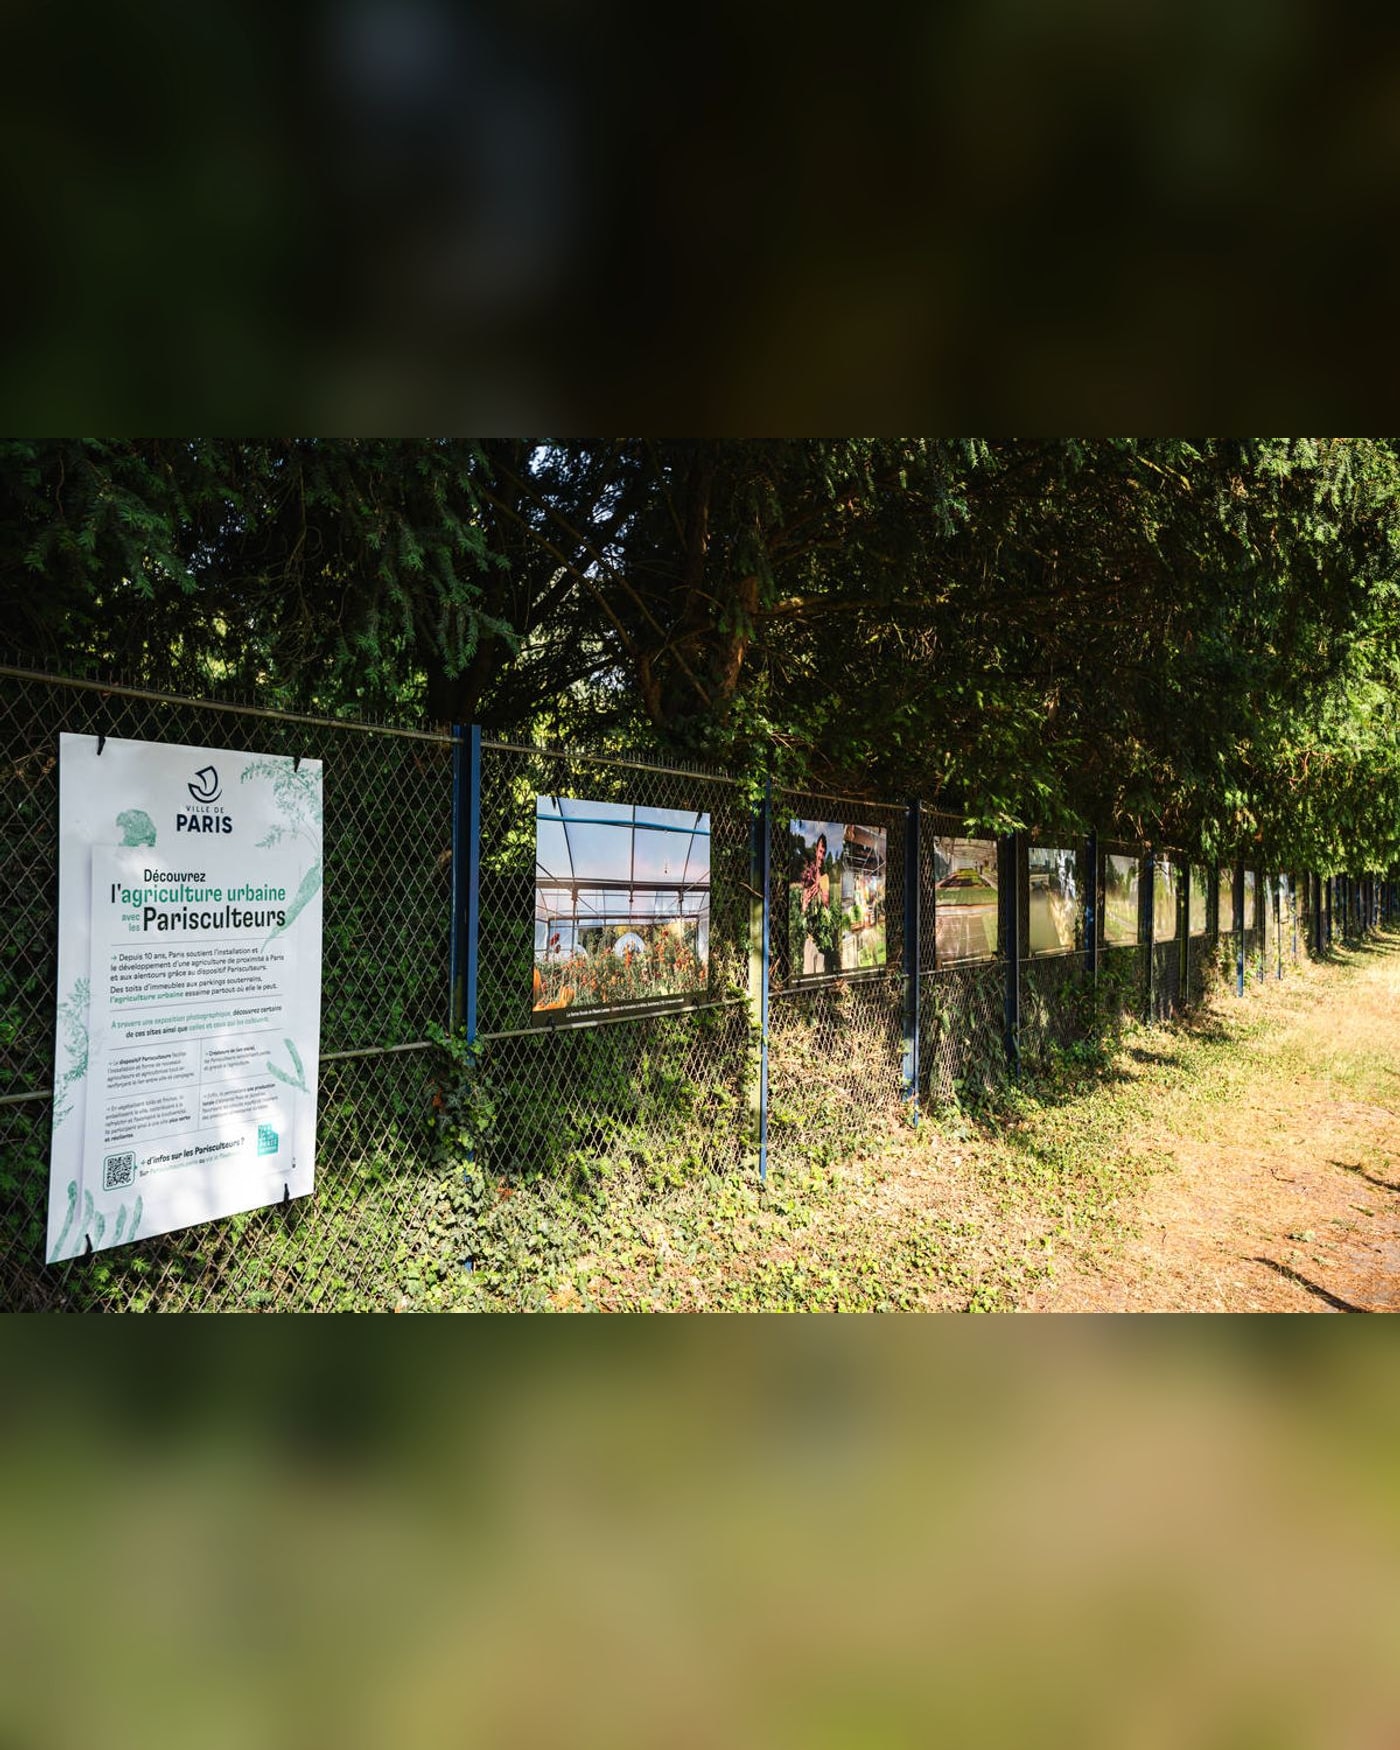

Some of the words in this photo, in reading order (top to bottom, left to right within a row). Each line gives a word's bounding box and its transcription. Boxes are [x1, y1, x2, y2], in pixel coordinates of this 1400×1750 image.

[176, 814, 232, 834] PARIS
[144, 869, 206, 882] Découvrez
[112, 884, 222, 908] l'agriculture
[228, 884, 286, 902] urbaine
[144, 906, 286, 931] Parisculteurs
[128, 923, 140, 932] les
[119, 962, 171, 971] développement
[168, 970, 186, 978] grâce
[197, 967, 226, 975] dispositif
[144, 982, 185, 991] d'immeubles
[110, 994, 155, 1004] l'agriculture
[147, 1154, 170, 1165] d'infos
[172, 1152, 182, 1160] sur
[184, 1148, 193, 1157] les
[195, 1141, 240, 1155] Parisculteurs
